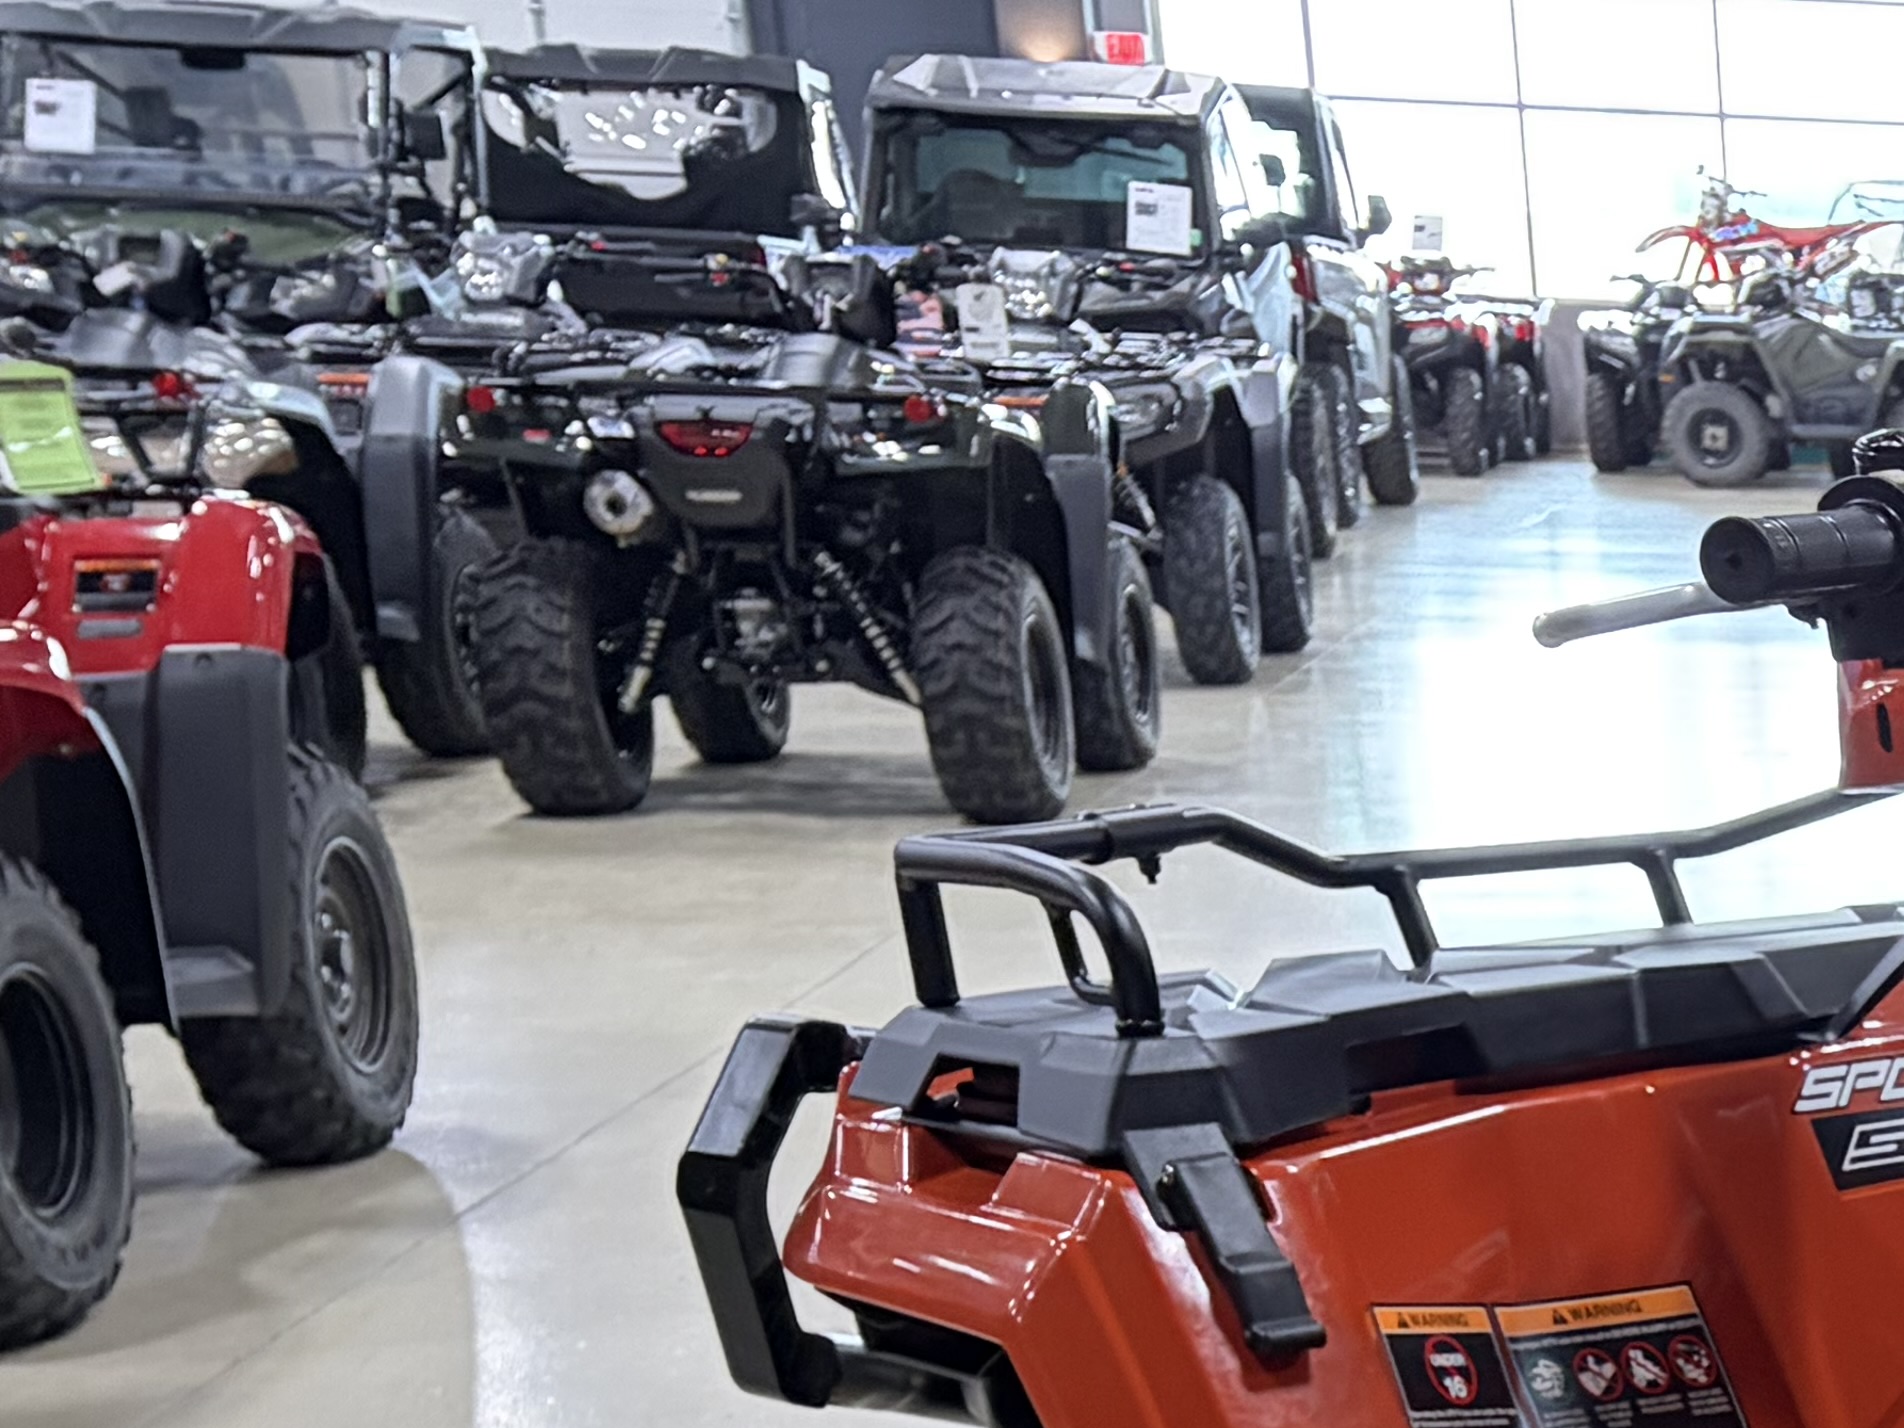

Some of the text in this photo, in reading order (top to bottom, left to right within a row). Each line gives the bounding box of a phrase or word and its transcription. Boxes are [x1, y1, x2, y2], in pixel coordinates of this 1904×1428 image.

[1408, 1312, 1470, 1328] WARNING
[1568, 1299, 1644, 1321] WARNING
[1442, 1375, 1469, 1399] 16
